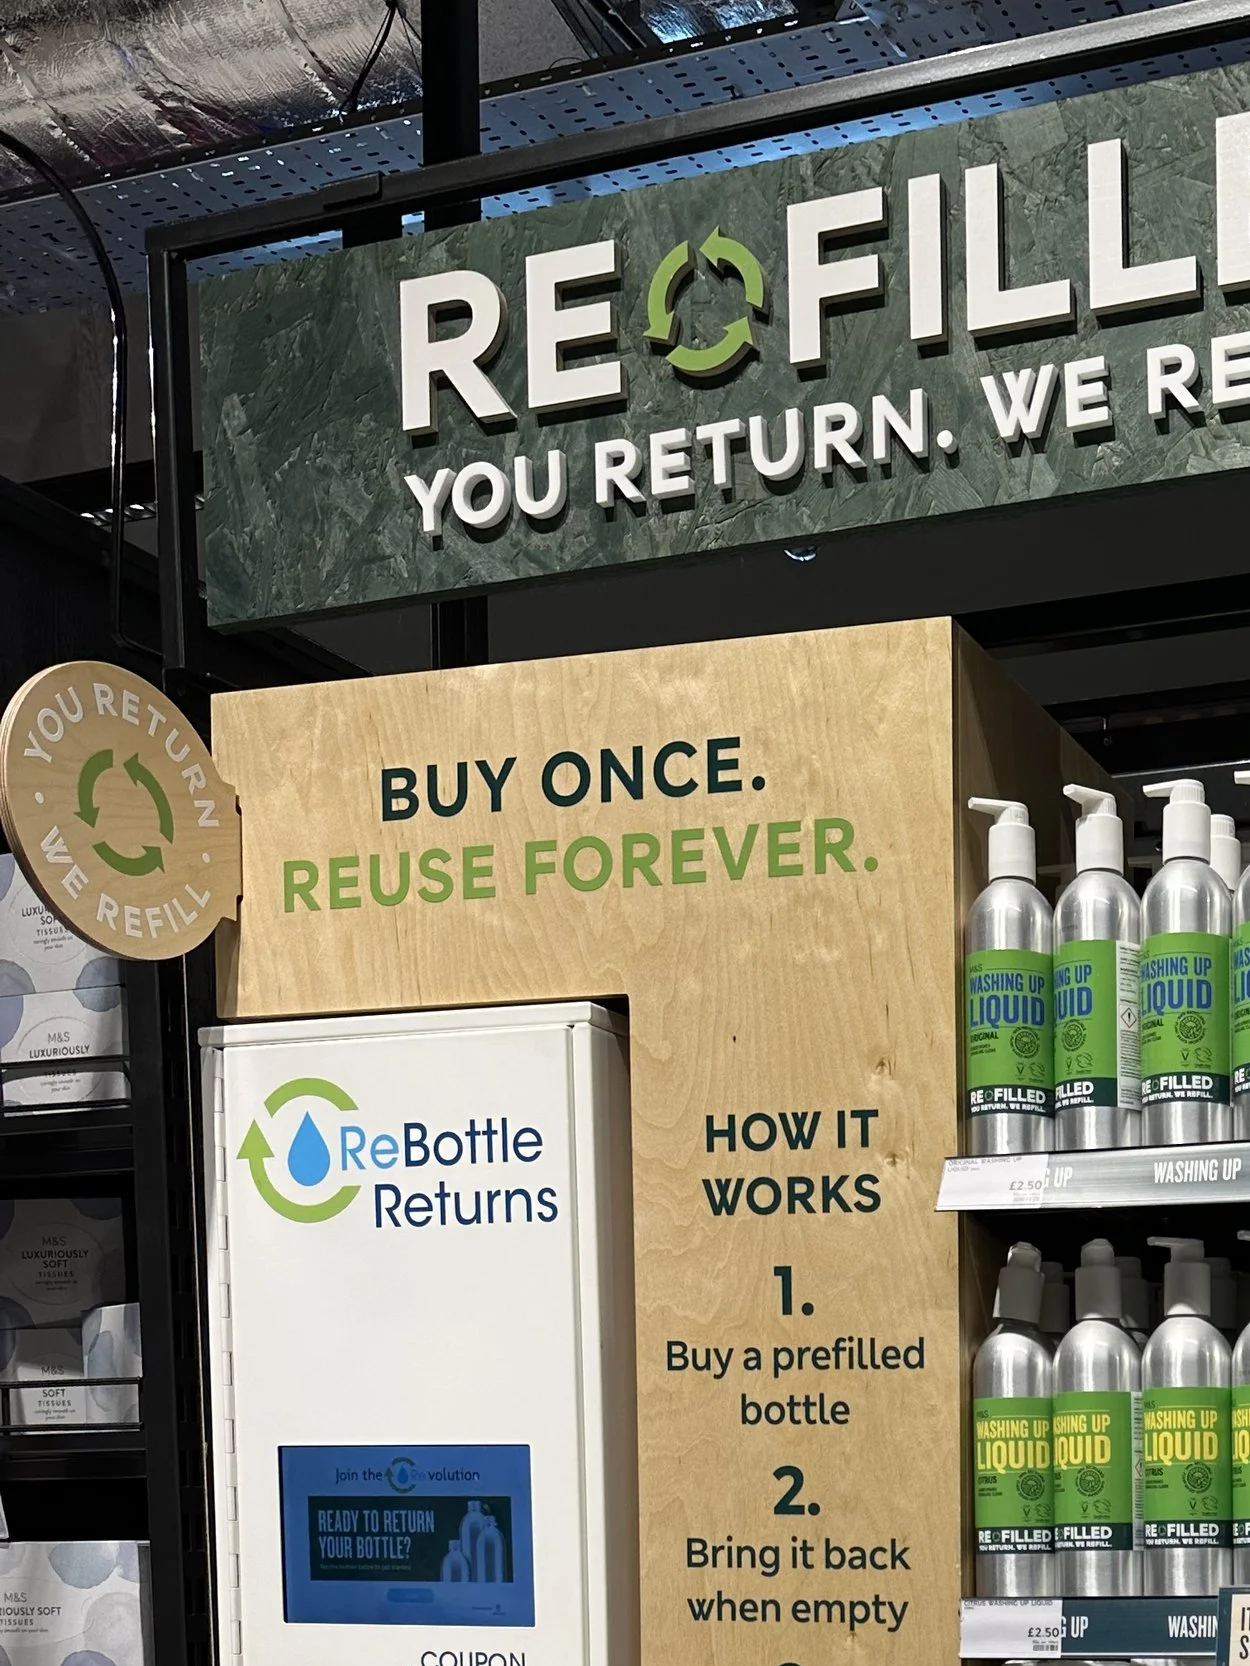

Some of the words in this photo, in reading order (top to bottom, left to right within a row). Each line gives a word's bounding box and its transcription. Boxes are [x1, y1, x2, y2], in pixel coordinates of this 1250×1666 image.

[405, 451, 566, 535] YOU
[595, 389, 956, 504] RETURN.
[984, 366, 1109, 446] WE
[24, 686, 84, 764] YOU
[93, 682, 219, 827] RETURN
[382, 758, 518, 822] BUY
[541, 736, 767, 801] ONCE.
[40, 826, 89, 900] WE
[96, 884, 210, 938] REFILL
[284, 850, 497, 913] REUSE
[525, 817, 879, 897] FOREVER.
[29, 1045, 90, 1059] LUXURIOUSLY
[341, 1117, 542, 1171] ReBottle
[706, 1111, 821, 1152] HOW
[837, 1109, 879, 1149] IT
[1154, 1160, 1215, 1183] WASHING
[1219, 1158, 1241, 1179] UP
[374, 1183, 558, 1228] Returns
[702, 1174, 881, 1216] WORKS
[773, 1265, 814, 1315] 1.
[666, 1340, 733, 1379] Buy
[744, 1346, 762, 1370] a
[774, 1337, 925, 1377] prefilled
[741, 1393, 850, 1425] bottle
[336, 1468, 358, 1484] Join
[363, 1468, 382, 1480] the
[773, 1465, 820, 1515] 2.
[318, 1510, 358, 1532] READY
[363, 1510, 379, 1532] TO
[384, 1510, 434, 1532] RETURN
[319, 1537, 352, 1559] YOUR
[358, 1537, 411, 1559] BOTTLE?
[686, 1536, 780, 1576] Bring
[792, 1538, 814, 1569] it
[825, 1538, 911, 1570] back
[687, 1591, 781, 1622] when
[792, 1598, 909, 1632] empty
[1028, 1626, 1059, 1638] £2.50
